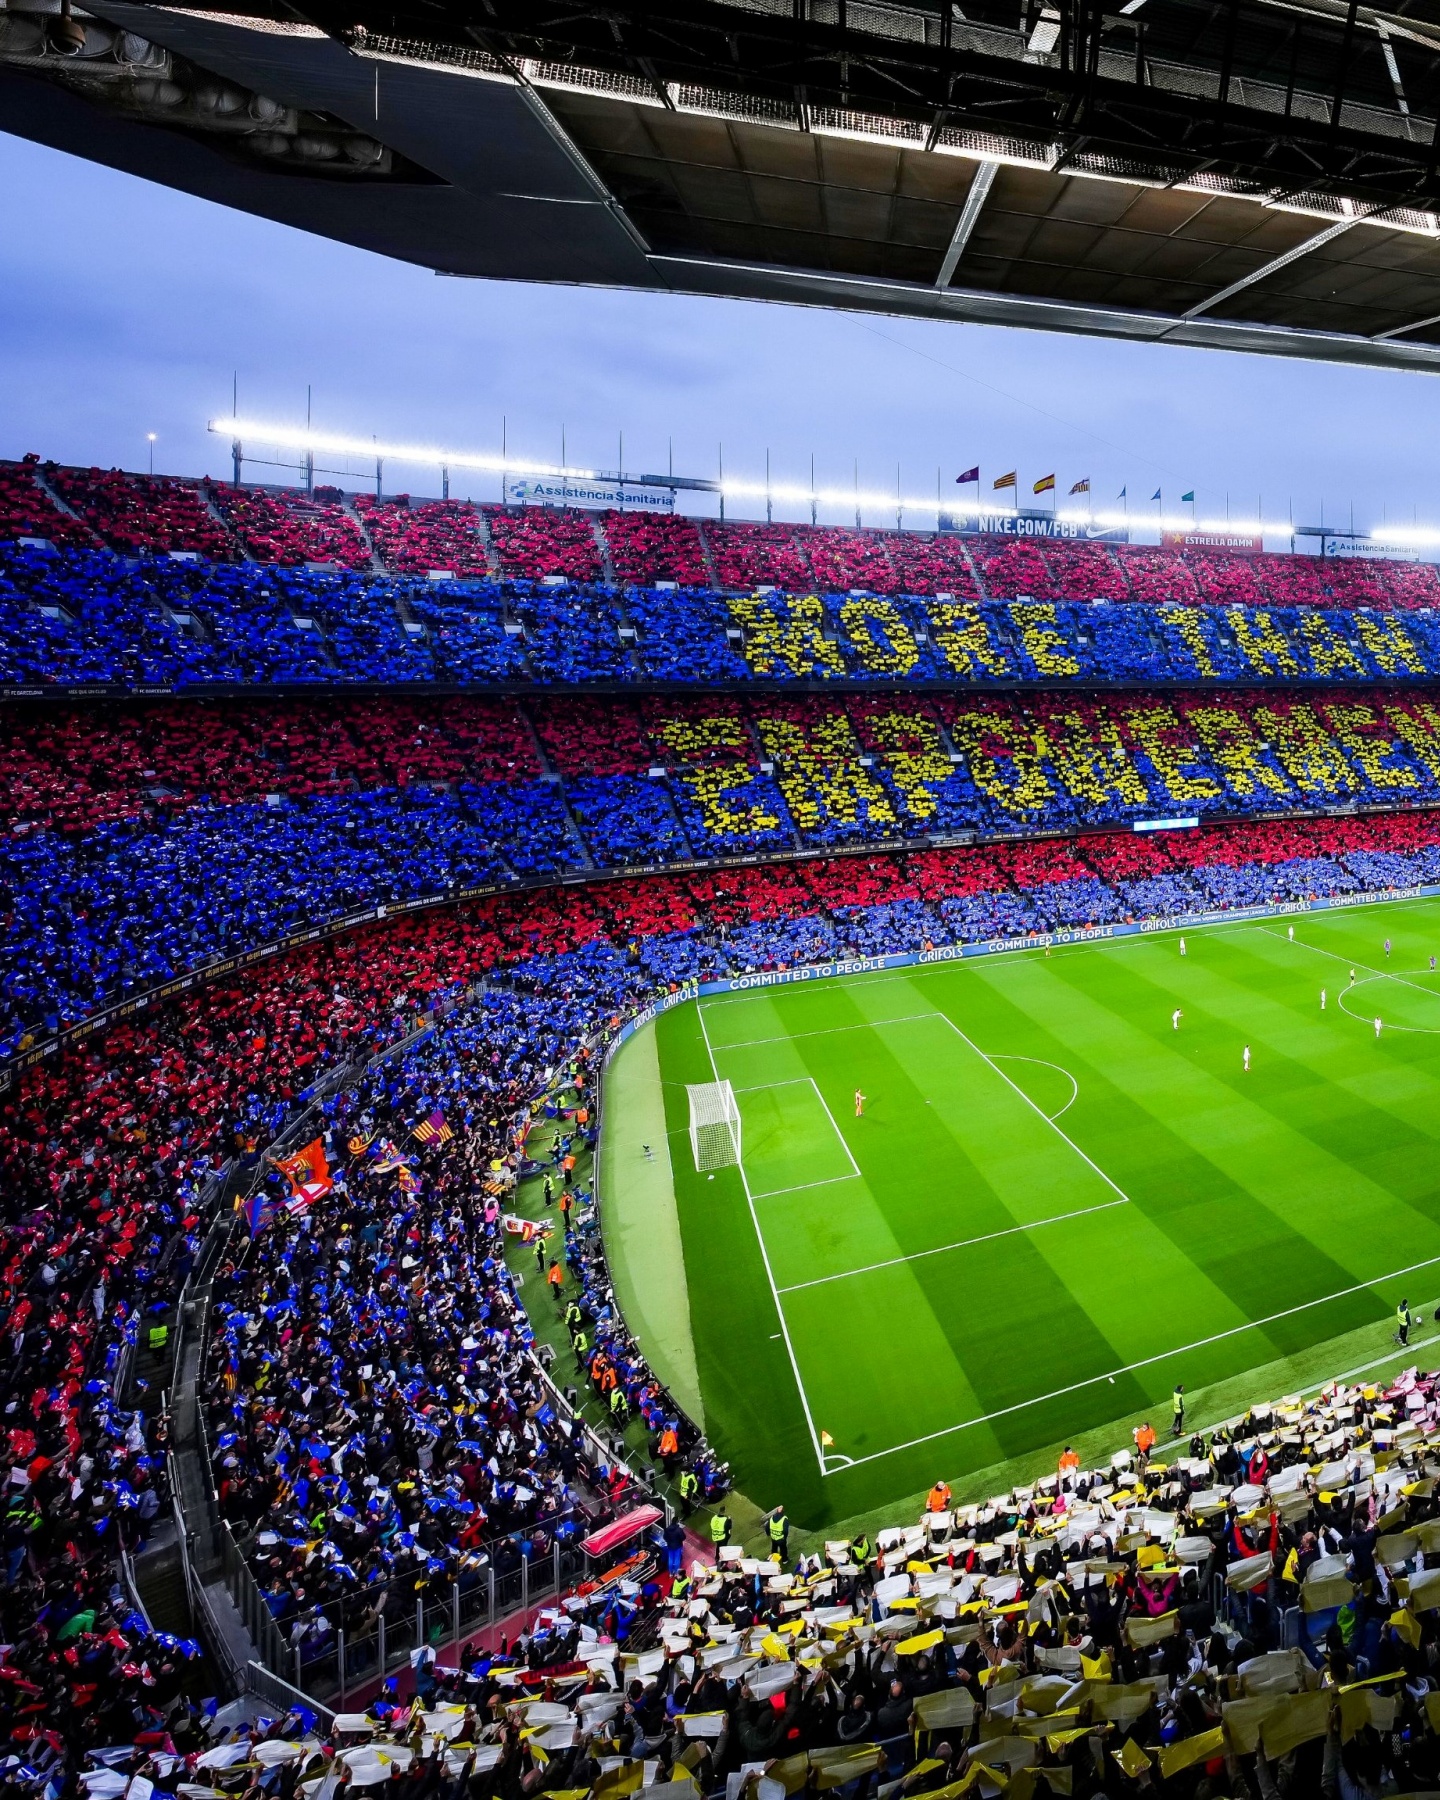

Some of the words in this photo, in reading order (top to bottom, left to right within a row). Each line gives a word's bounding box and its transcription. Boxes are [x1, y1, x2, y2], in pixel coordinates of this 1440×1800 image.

[534, 484, 614, 501] Assistència
[615, 492, 673, 506] Sanitària
[978, 516, 1078, 538] NIKE.COM/FCB
[1185, 536, 1225, 547] ESTRELLA
[1227, 537, 1253, 548] DAMM
[727, 594, 1080, 677] MORE
[1157, 607, 1427, 676] THAN
[1279, 901, 1311, 913] GRIFOLS
[1329, 894, 1376, 907] COMMITTED
[1379, 893, 1389, 901] TO
[1391, 889, 1421, 900] PEOPLE
[1140, 918, 1177, 932] GRIFOLS
[1223, 911, 1249, 919] CHAMPIONS
[1250, 909, 1265, 917] LEAGUE
[989, 936, 1053, 952] COMMITTED
[1056, 934, 1071, 943] TO
[1074, 928, 1113, 941] PEOPLE
[919, 948, 963, 963] GRIFOLS
[729, 970, 811, 990] COMMITTED
[814, 966, 833, 978] TO
[836, 958, 885, 974] PEOPLE
[663, 986, 699, 1009] GRIFOLS
[633, 1004, 657, 1030] GRIFOLS
